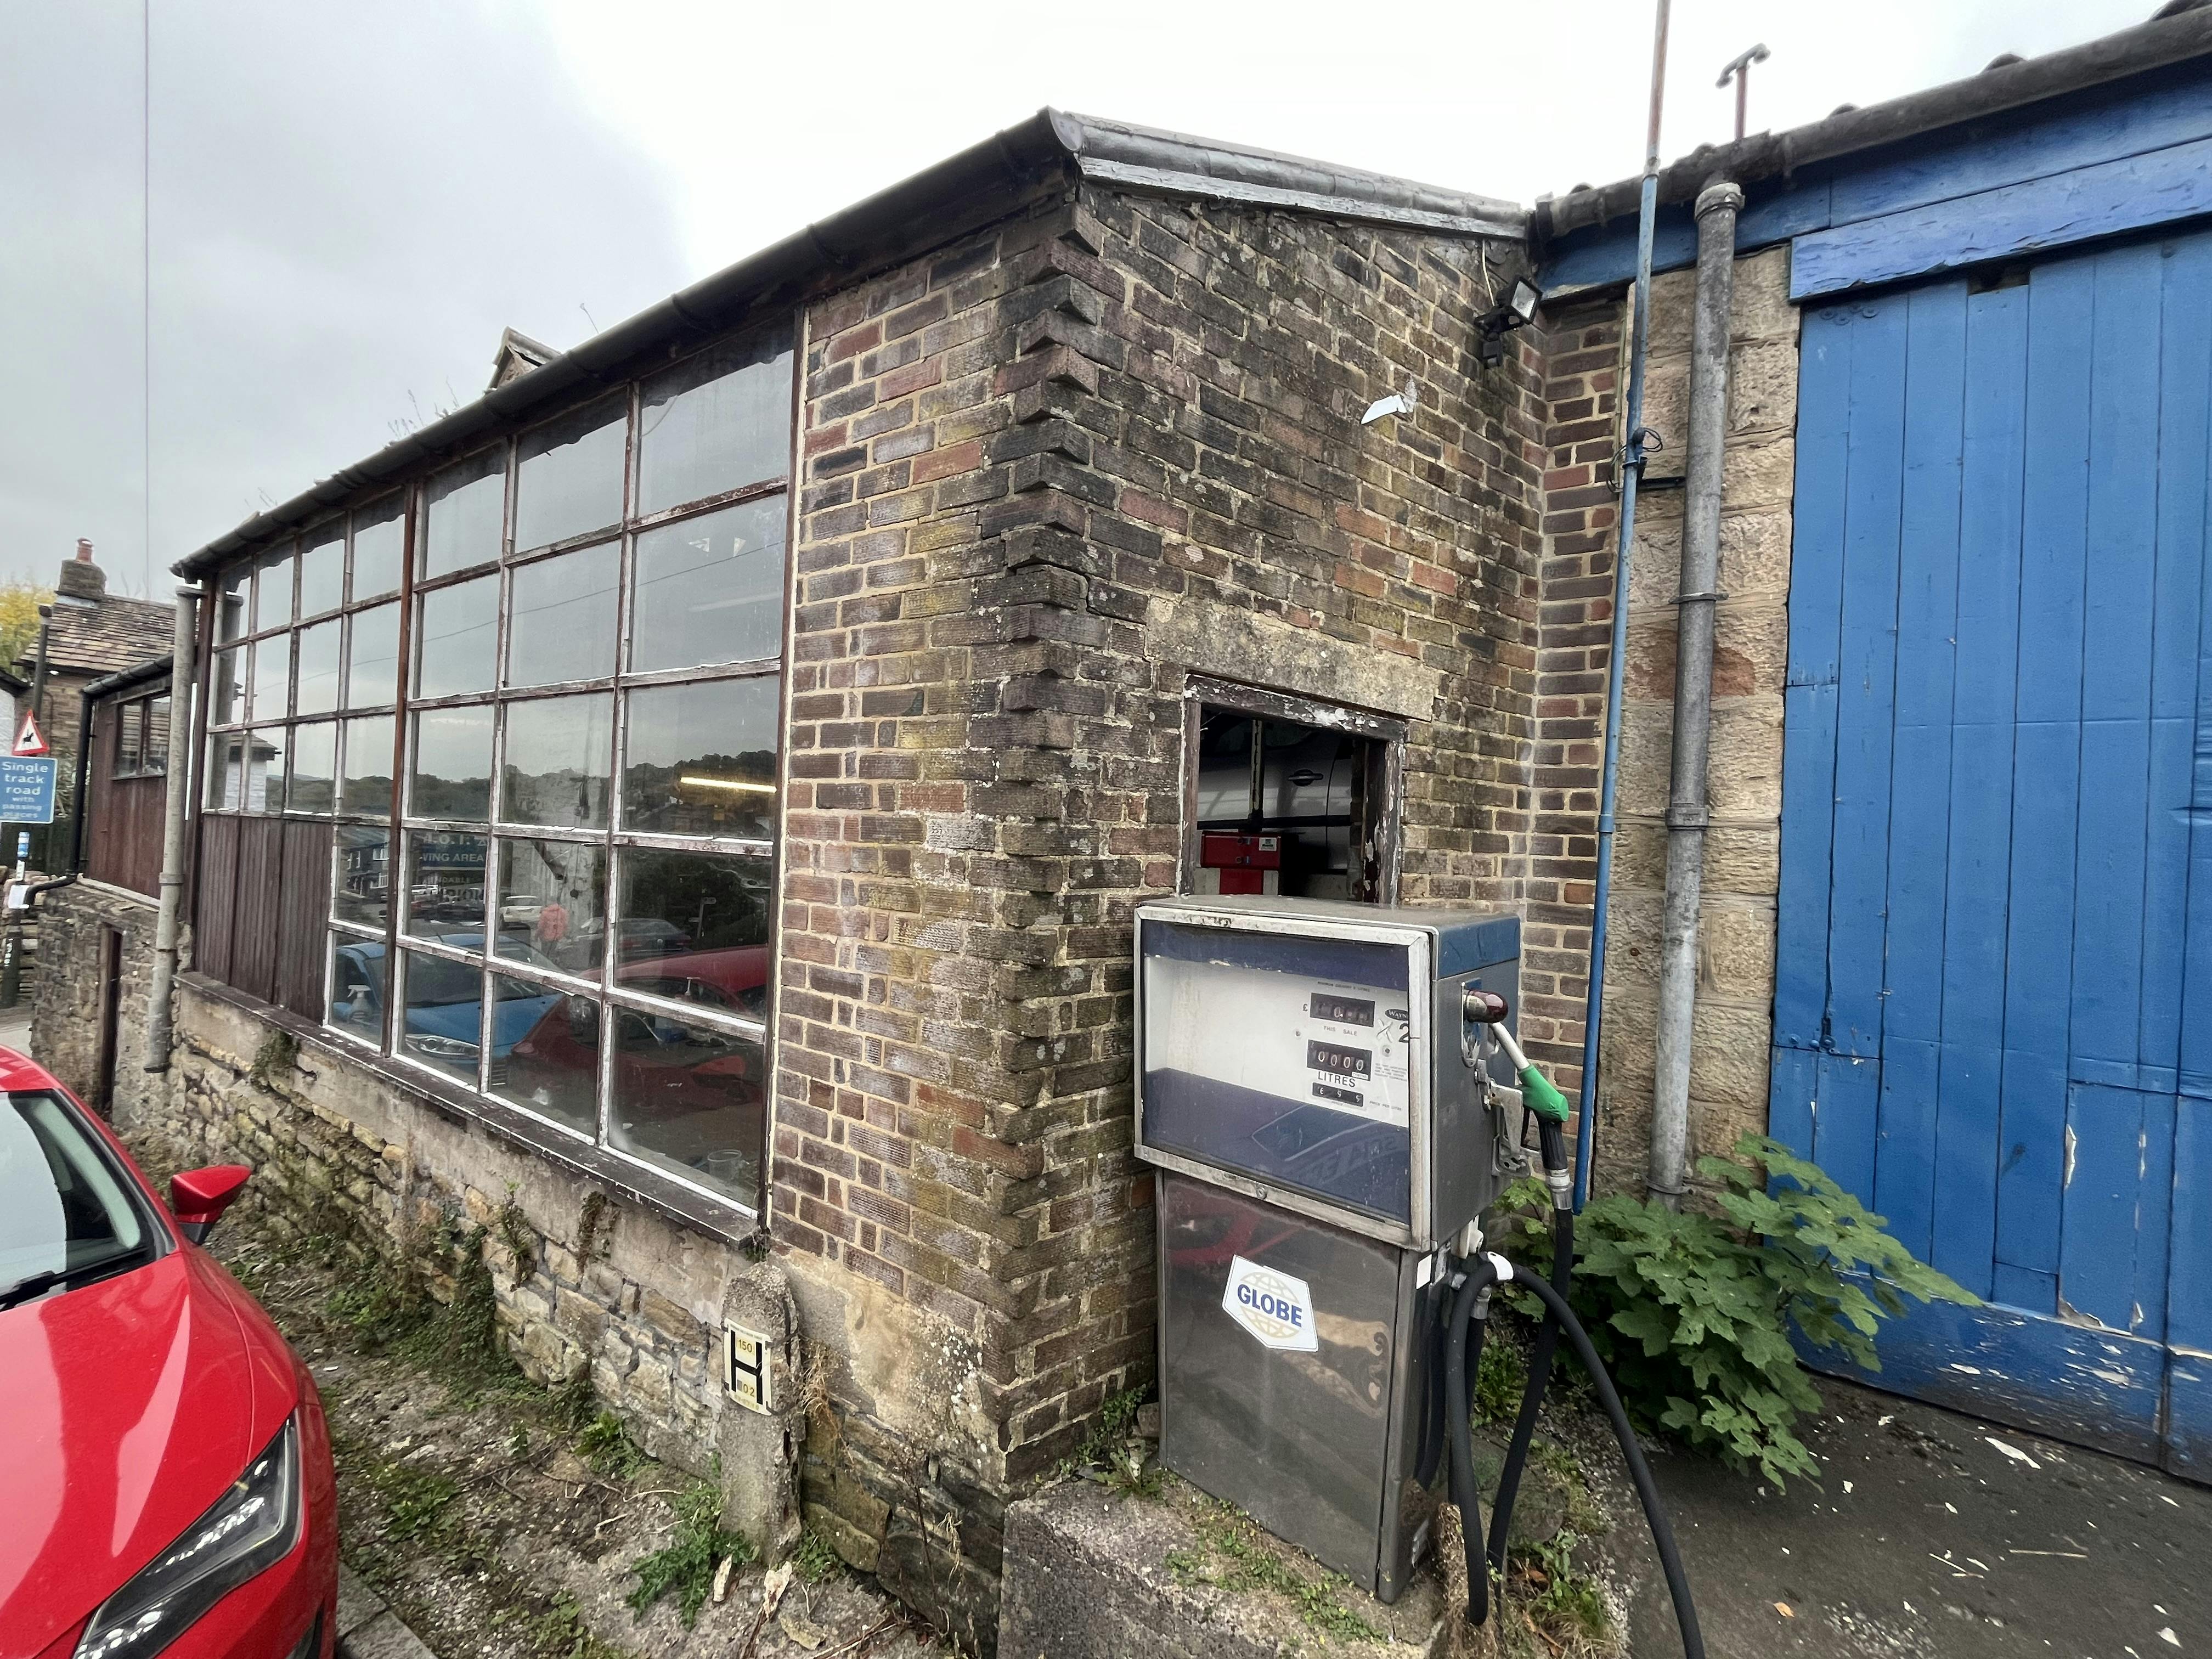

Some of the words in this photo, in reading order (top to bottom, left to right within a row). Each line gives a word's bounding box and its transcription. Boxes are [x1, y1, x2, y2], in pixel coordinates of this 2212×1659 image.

[2, 761, 49, 774] Single
[5, 774, 44, 784] track
[5, 786, 41, 795] road
[452, 854, 484, 862] AREA
[1318, 1071, 1356, 1088] LITRES
[1237, 1284, 1302, 1328] GLOBE
[738, 1339, 753, 1353] 150
[731, 1330, 763, 1405] H
